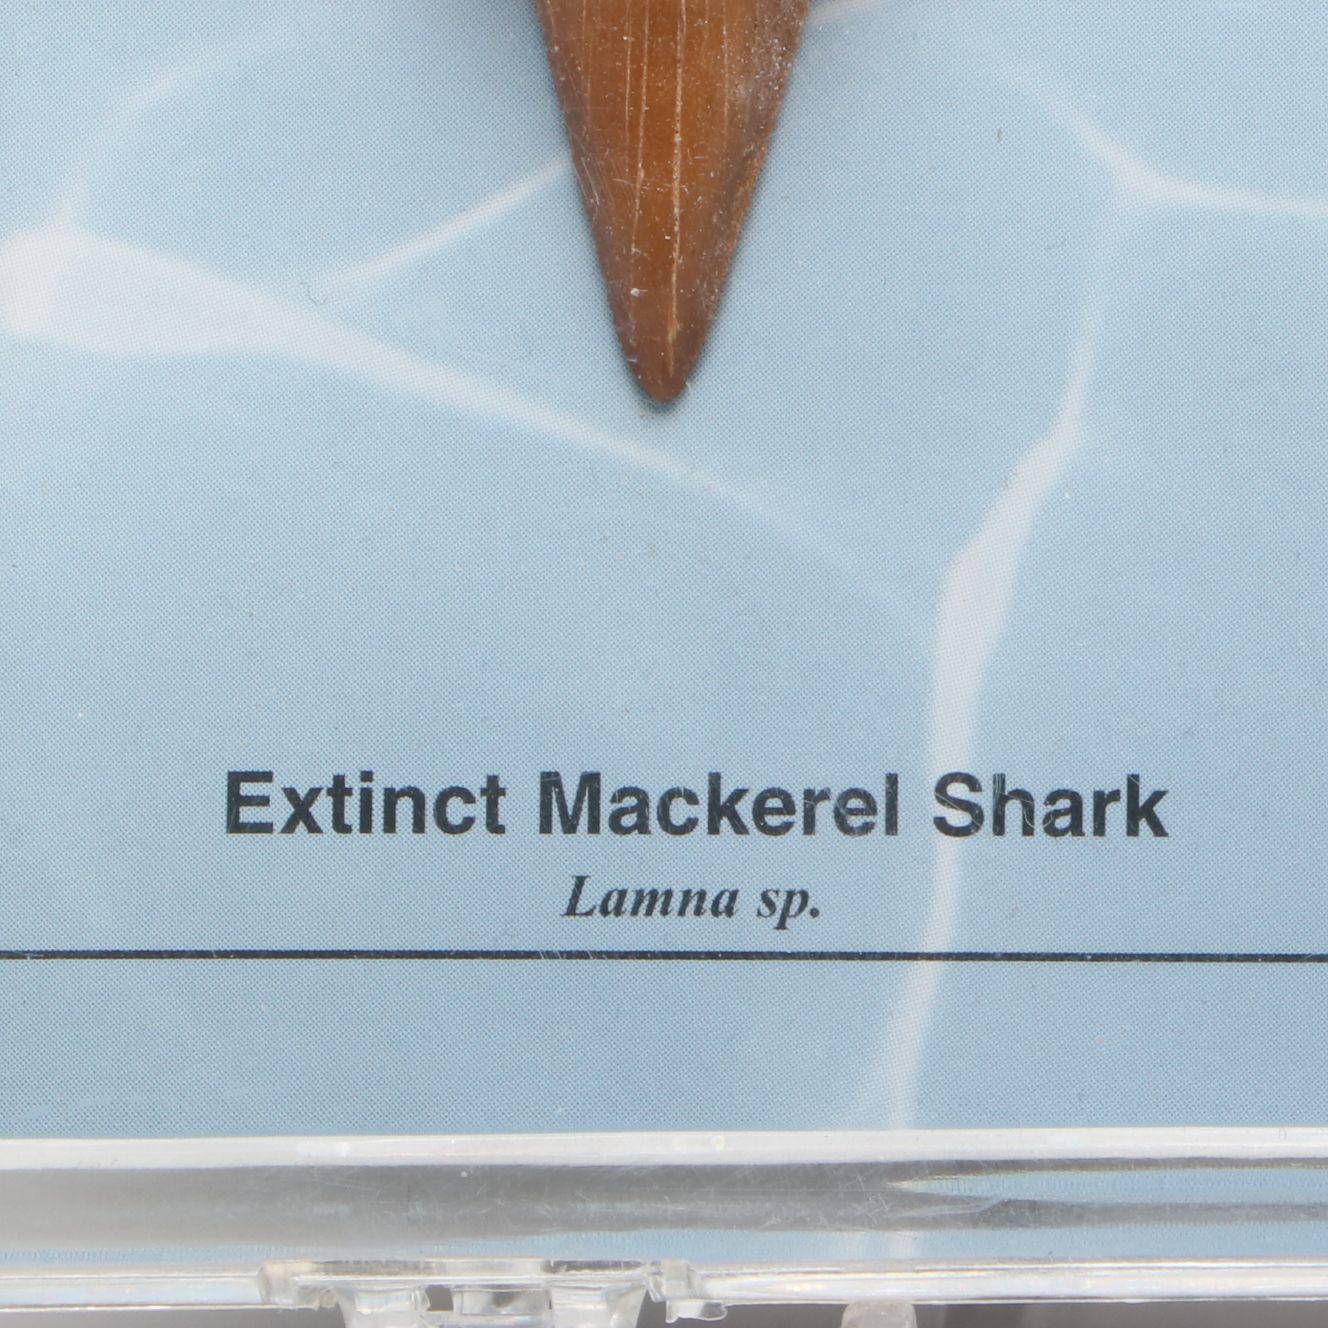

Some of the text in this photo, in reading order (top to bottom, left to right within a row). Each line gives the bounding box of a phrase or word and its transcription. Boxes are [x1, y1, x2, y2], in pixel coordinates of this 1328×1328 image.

[225, 769, 1170, 839] Extinct Mackerel Shark
[561, 873, 821, 932] Lamna sp.
